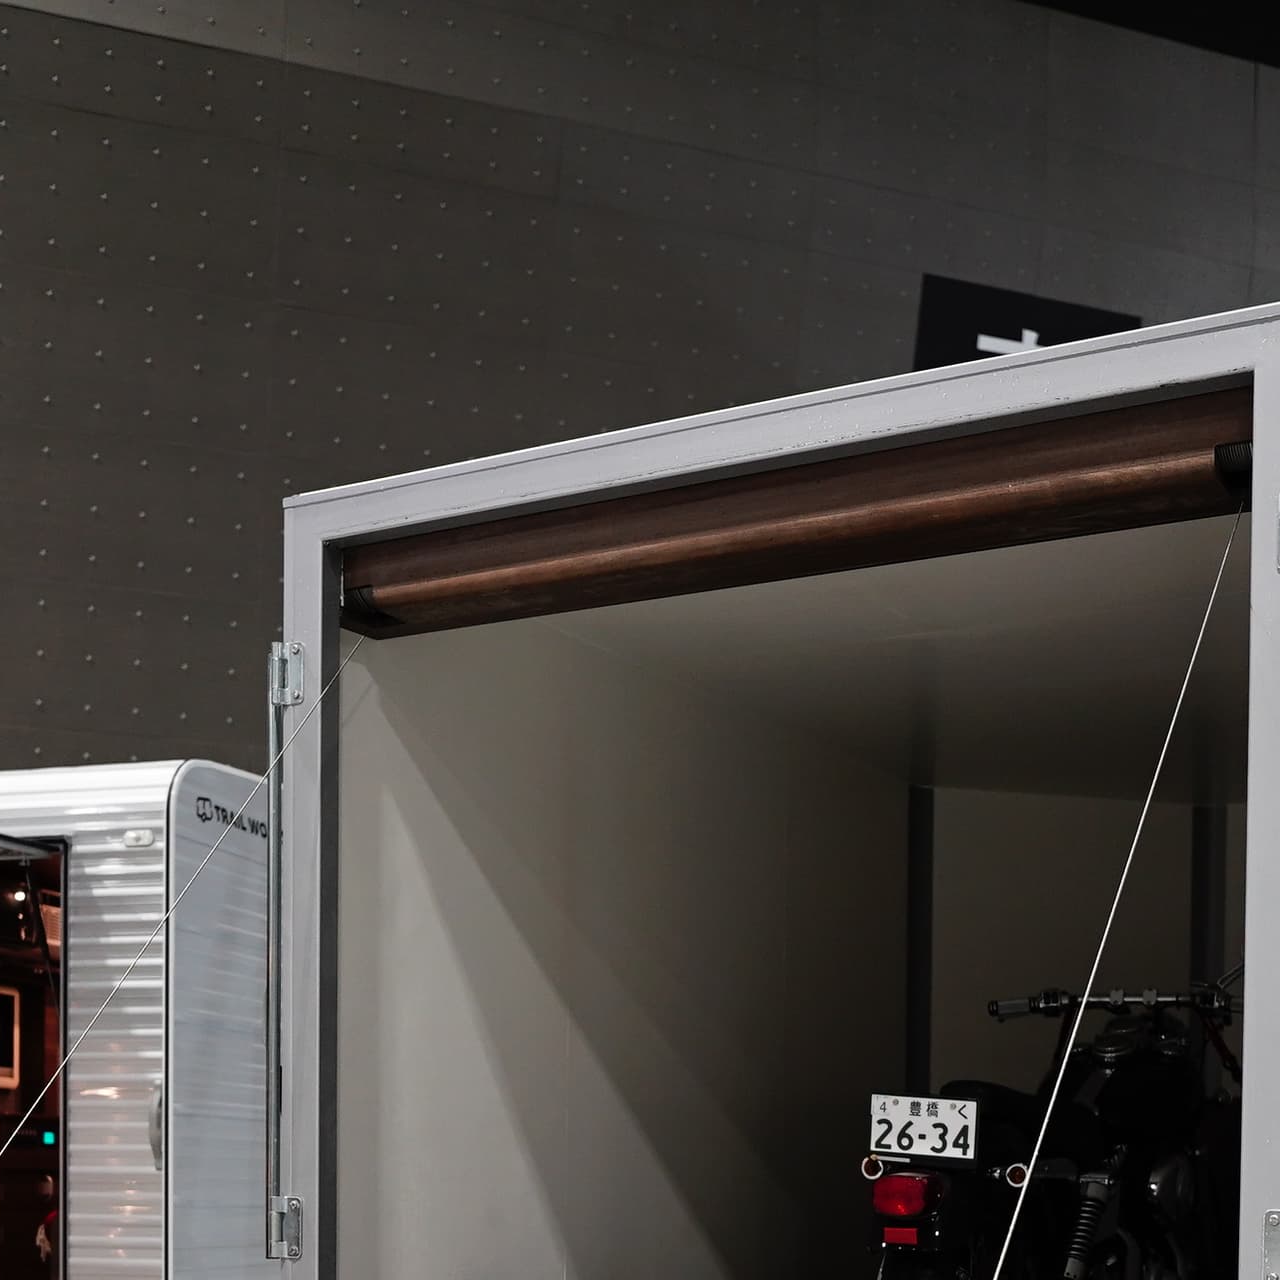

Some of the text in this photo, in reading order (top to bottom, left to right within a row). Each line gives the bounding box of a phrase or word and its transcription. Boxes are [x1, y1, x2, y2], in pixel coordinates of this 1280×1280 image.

[879, 1101, 887, 1113] 4
[909, 1100, 968, 1119] 豊橋 く
[874, 1118, 970, 1156] 26-34
